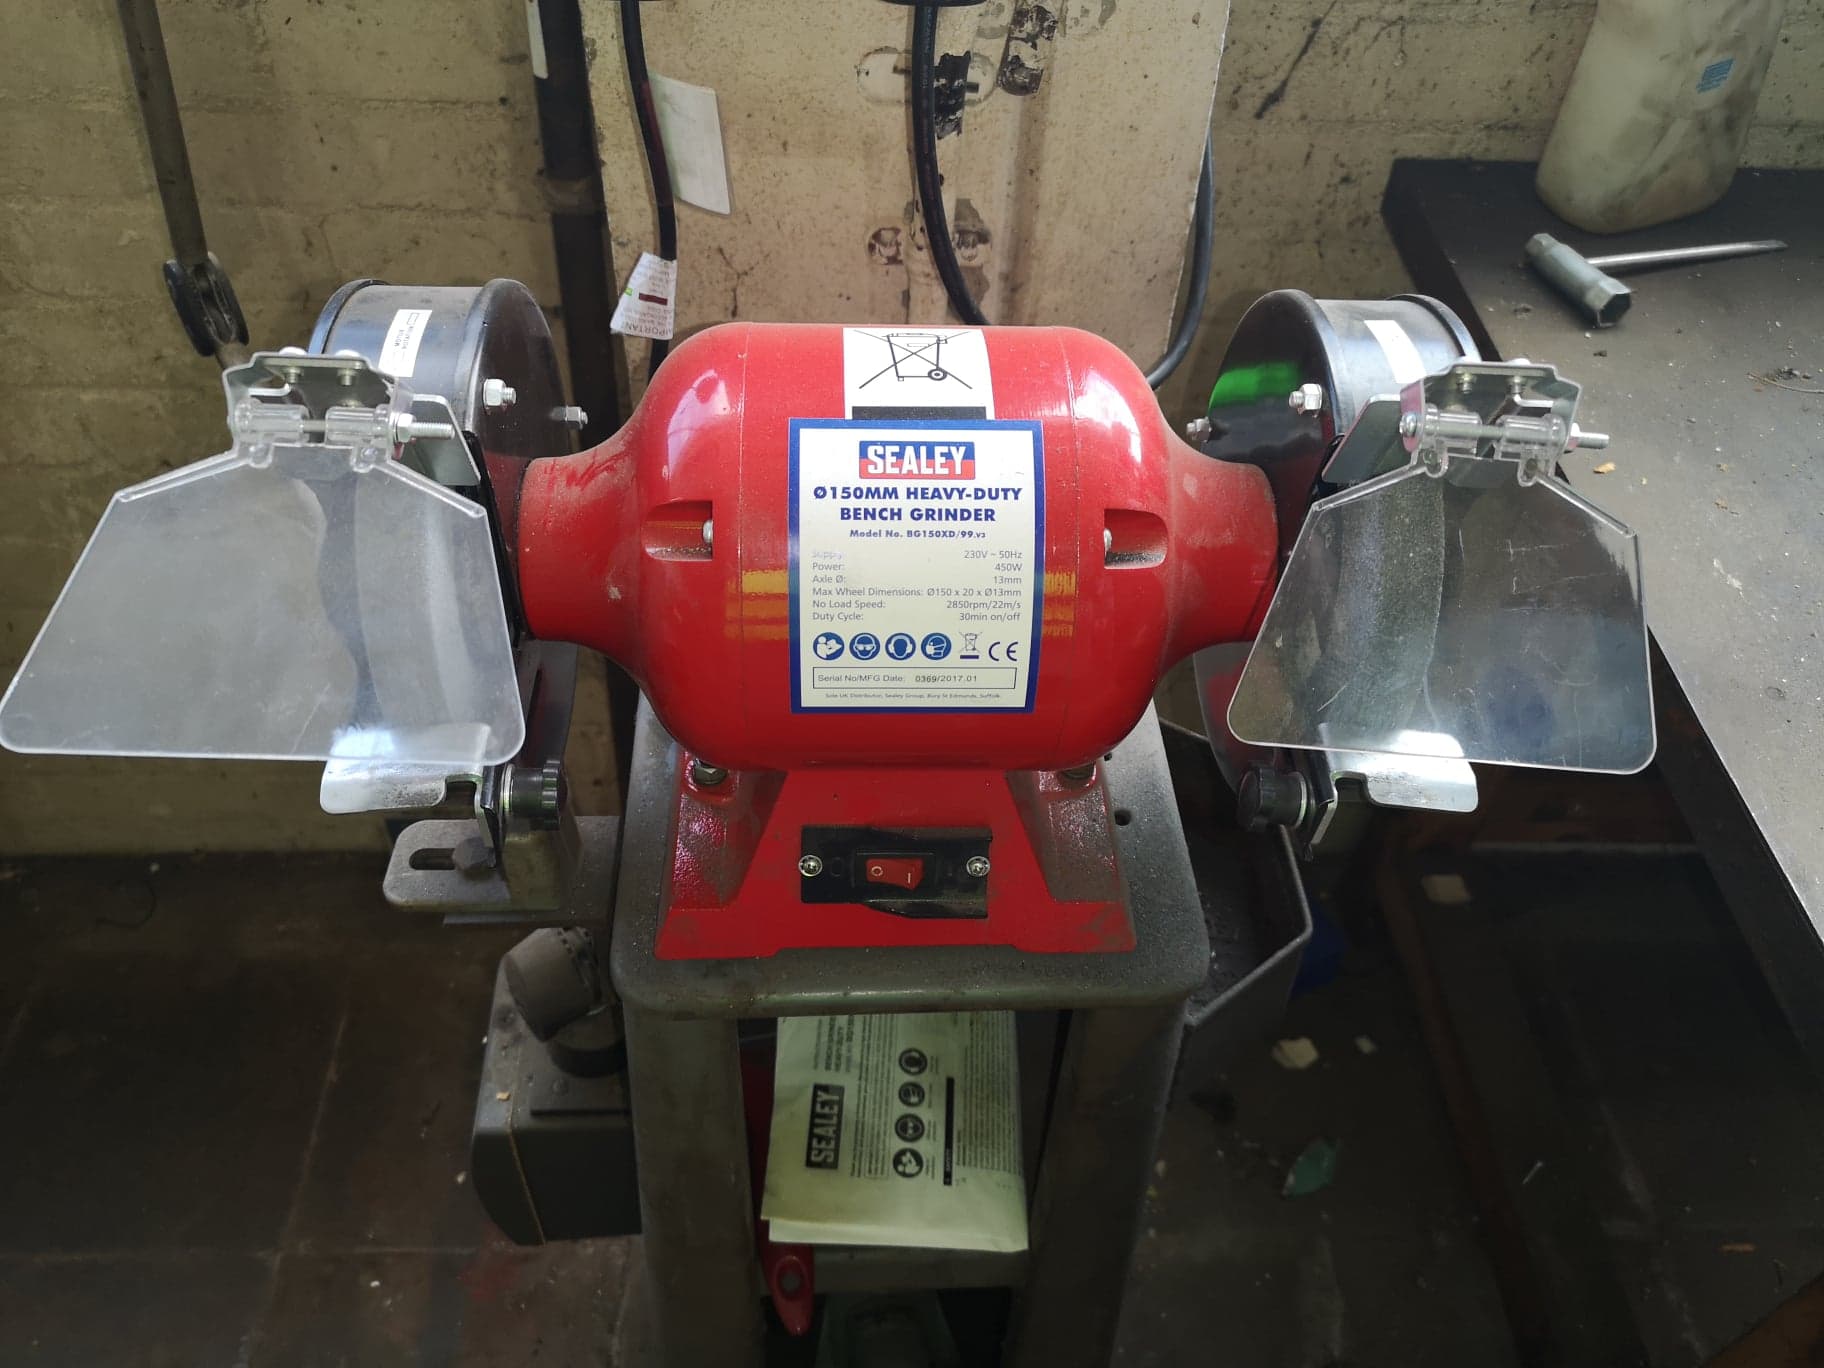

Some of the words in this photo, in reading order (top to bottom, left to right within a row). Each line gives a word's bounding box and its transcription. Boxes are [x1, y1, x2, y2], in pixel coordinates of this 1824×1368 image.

[866, 445, 967, 475] SEALEY
[813, 486, 899, 500] Ø150MM
[906, 487, 1023, 501] HEAVY-DUTY
[840, 508, 903, 521] BENCH
[910, 508, 996, 522] GRINDER
[849, 529, 882, 538] Model
[885, 529, 903, 538] No.
[964, 550, 988, 560] 230V
[999, 550, 1023, 560] 50Hz
[812, 562, 845, 572] Power:
[995, 562, 1023, 572] 450W
[812, 574, 833, 584] Axle
[994, 575, 1022, 584] 13mm
[812, 587, 832, 597] Max
[834, 587, 866, 597] Wheel
[868, 587, 924, 597] Dimensions:
[927, 588, 952, 597] Ø150
[962, 588, 974, 597] 20
[984, 588, 1022, 597] Ø13mm
[812, 600, 826, 609] No
[828, 600, 853, 609] Load
[854, 600, 886, 610] Speed:
[946, 600, 1022, 611] 2850rpm/22m/s
[812, 612, 835, 622] Duty
[837, 612, 864, 622] Cycle:
[959, 612, 988, 621] 30min
[990, 612, 1021, 622] on/off
[988, 641, 1019, 662] CE
[817, 674, 843, 683] Serial
[844, 674, 881, 683] No/MFG
[809, 1086, 842, 1164] SEALEY
